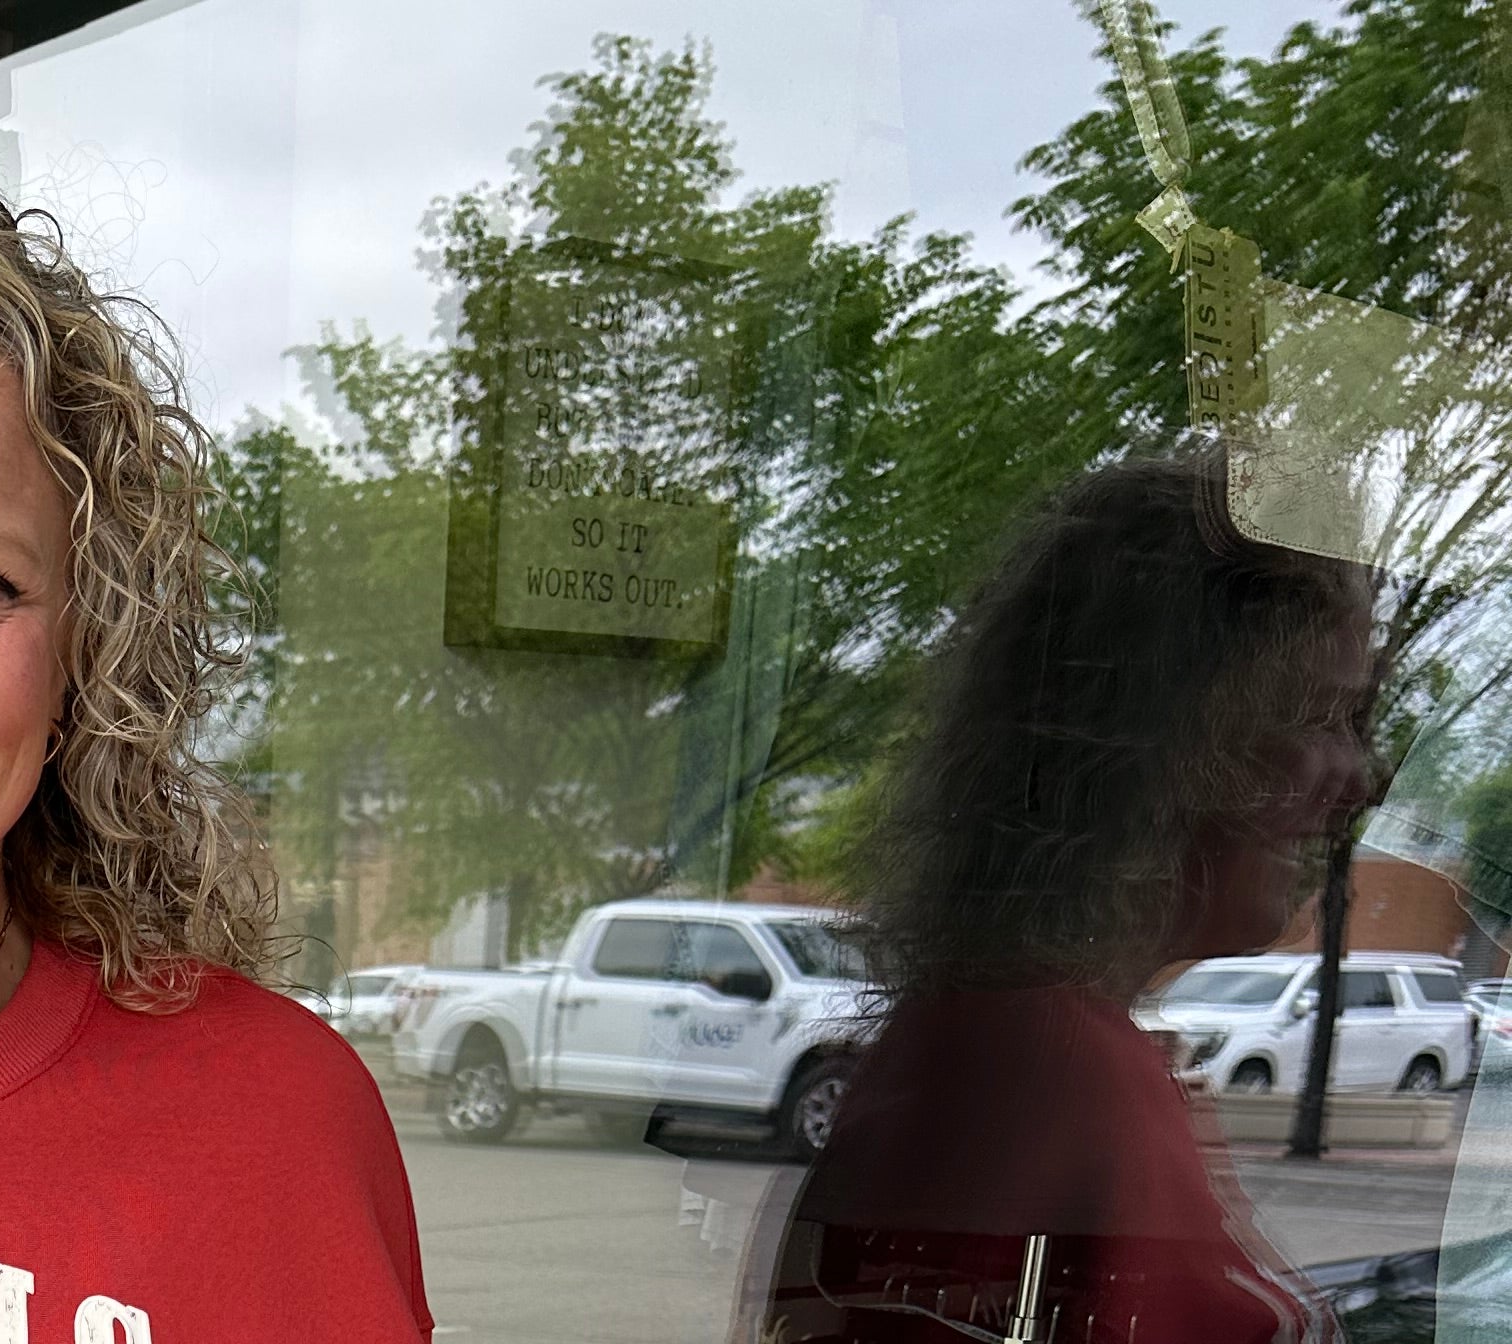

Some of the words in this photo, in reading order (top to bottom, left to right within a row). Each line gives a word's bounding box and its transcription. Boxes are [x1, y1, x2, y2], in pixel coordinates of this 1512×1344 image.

[571, 517, 604, 549] SO
[616, 521, 649, 554] IT
[527, 566, 614, 603] WORKS
[624, 574, 684, 610] OUT.
